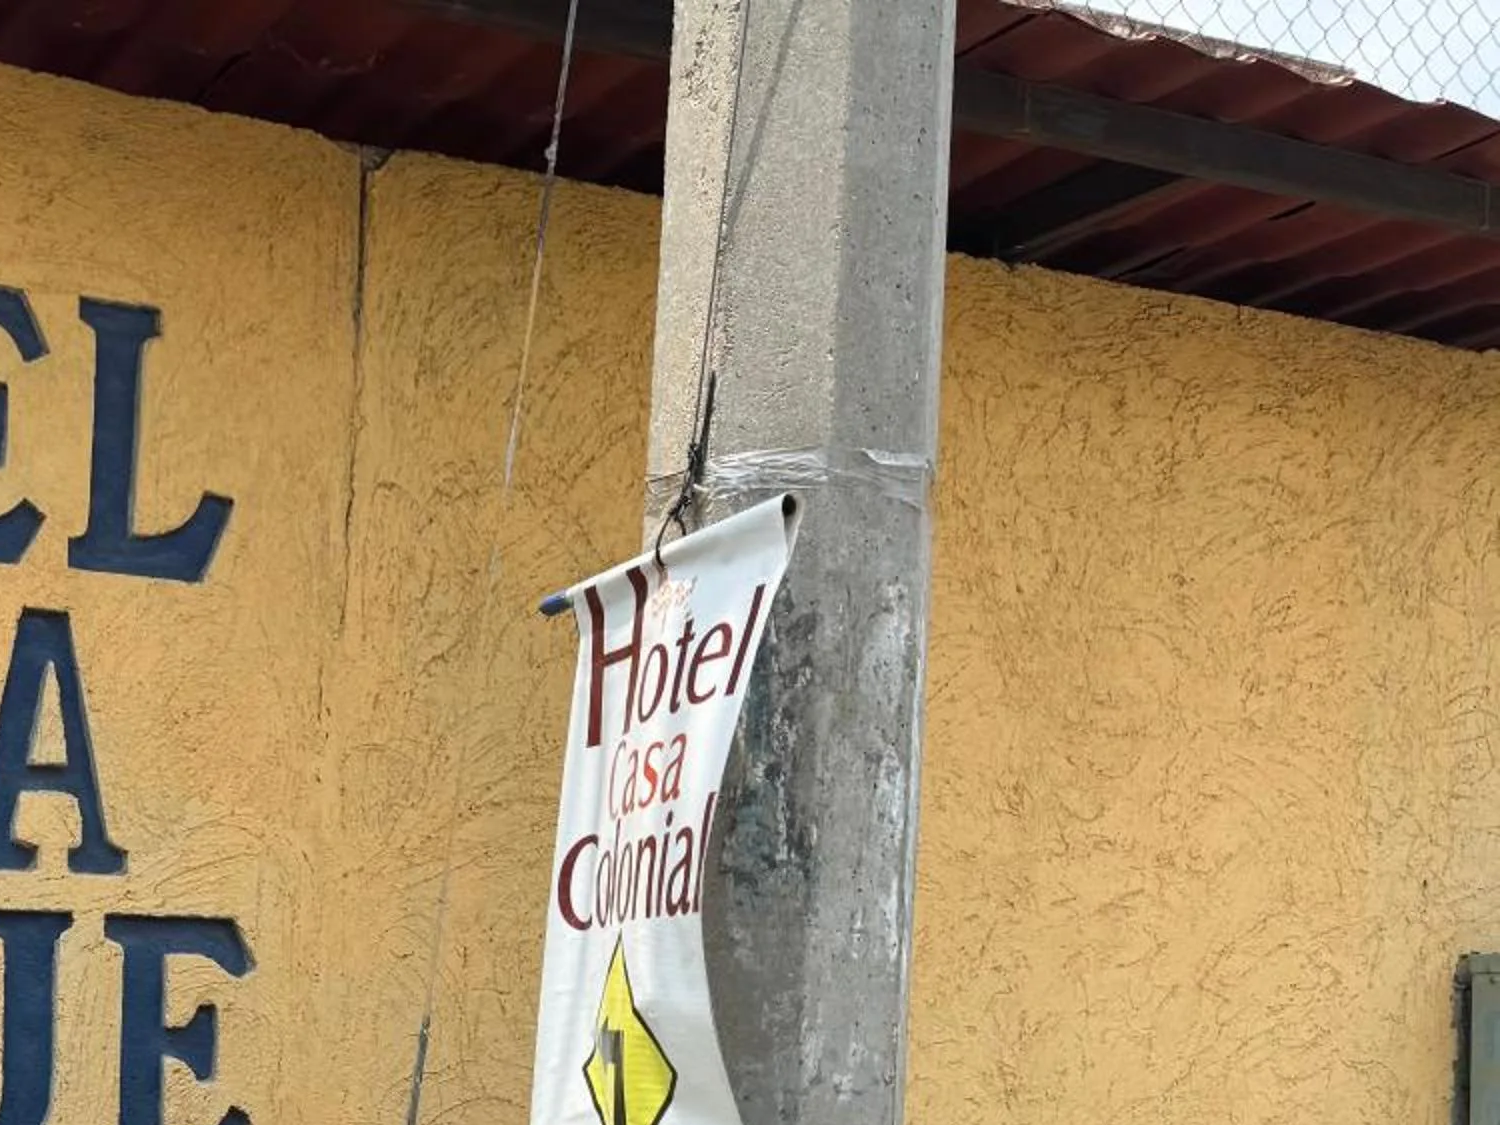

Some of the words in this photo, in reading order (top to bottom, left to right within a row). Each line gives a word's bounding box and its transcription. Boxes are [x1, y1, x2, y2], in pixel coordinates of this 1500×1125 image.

[583, 565, 766, 748] Hotel
[608, 732, 688, 821] Casa
[557, 791, 717, 931] Colonial
